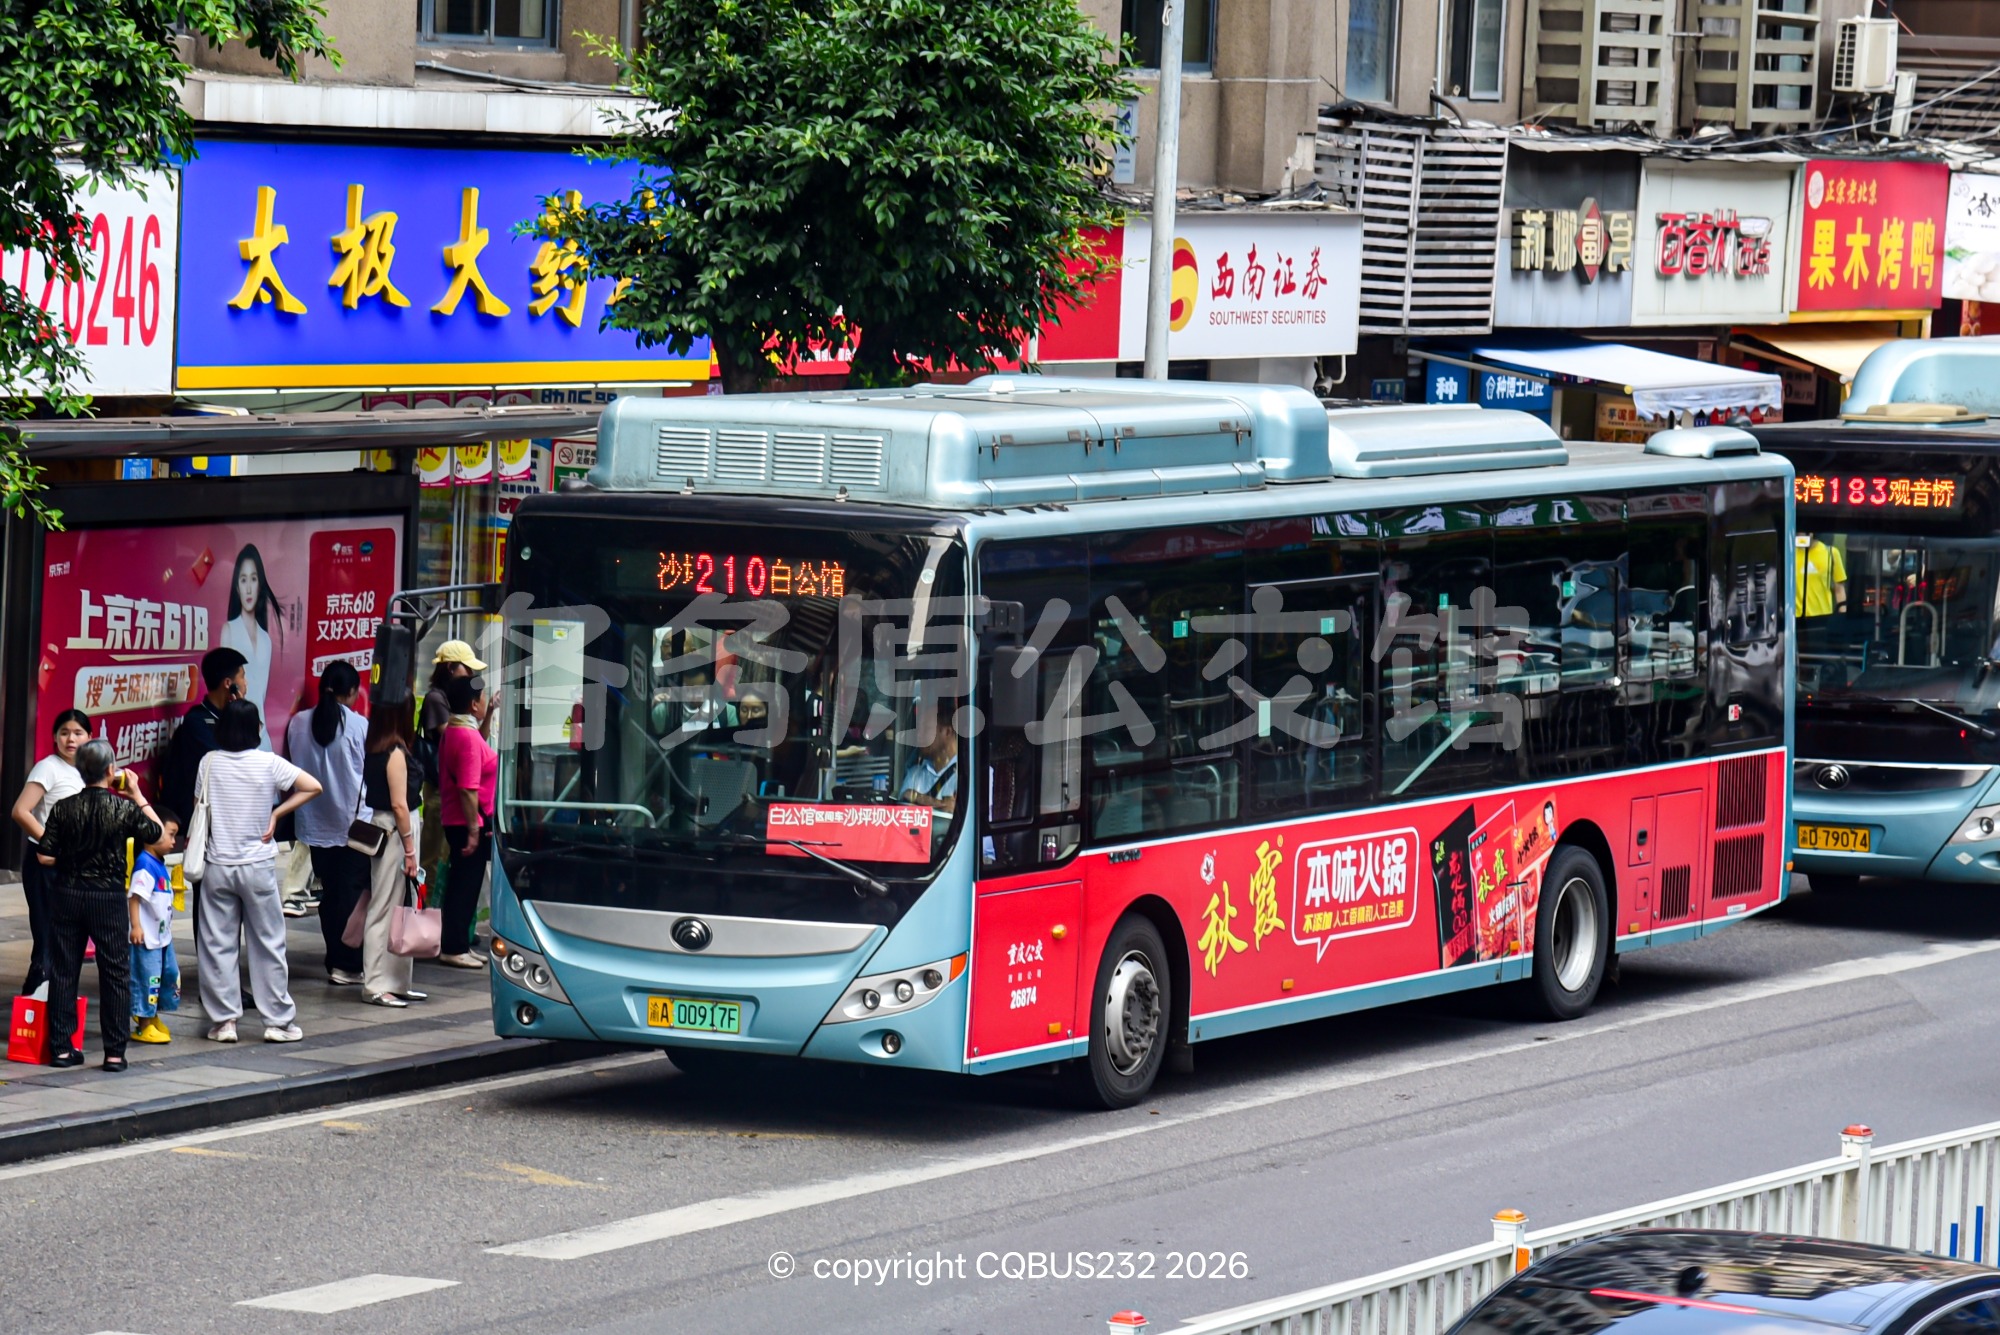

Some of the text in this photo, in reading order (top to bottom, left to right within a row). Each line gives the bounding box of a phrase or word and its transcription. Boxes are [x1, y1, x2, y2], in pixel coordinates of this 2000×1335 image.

[1825, 177, 1877, 206] 正宗老北京
[1512, 209, 1633, 273] 莉娜副食
[1808, 217, 1936, 290] 果木烤鸭
[1211, 242, 1328, 303] 西南证券
[1209, 310, 1327, 325] SOUTHWEST SECURITIES
[1435, 376, 1459, 400] 种
[1829, 477, 1888, 505] 183
[1888, 478, 1955, 508] 观音桥
[696, 554, 767, 597] 210
[770, 558, 846, 598] 白公馆
[327, 591, 375, 615] 京东618
[65, 588, 209, 651] 上京东618
[1305, 837, 1407, 908] 本味火锅
[1007, 939, 1044, 967] 重庆公交
[1010, 985, 1037, 1010] 26874
